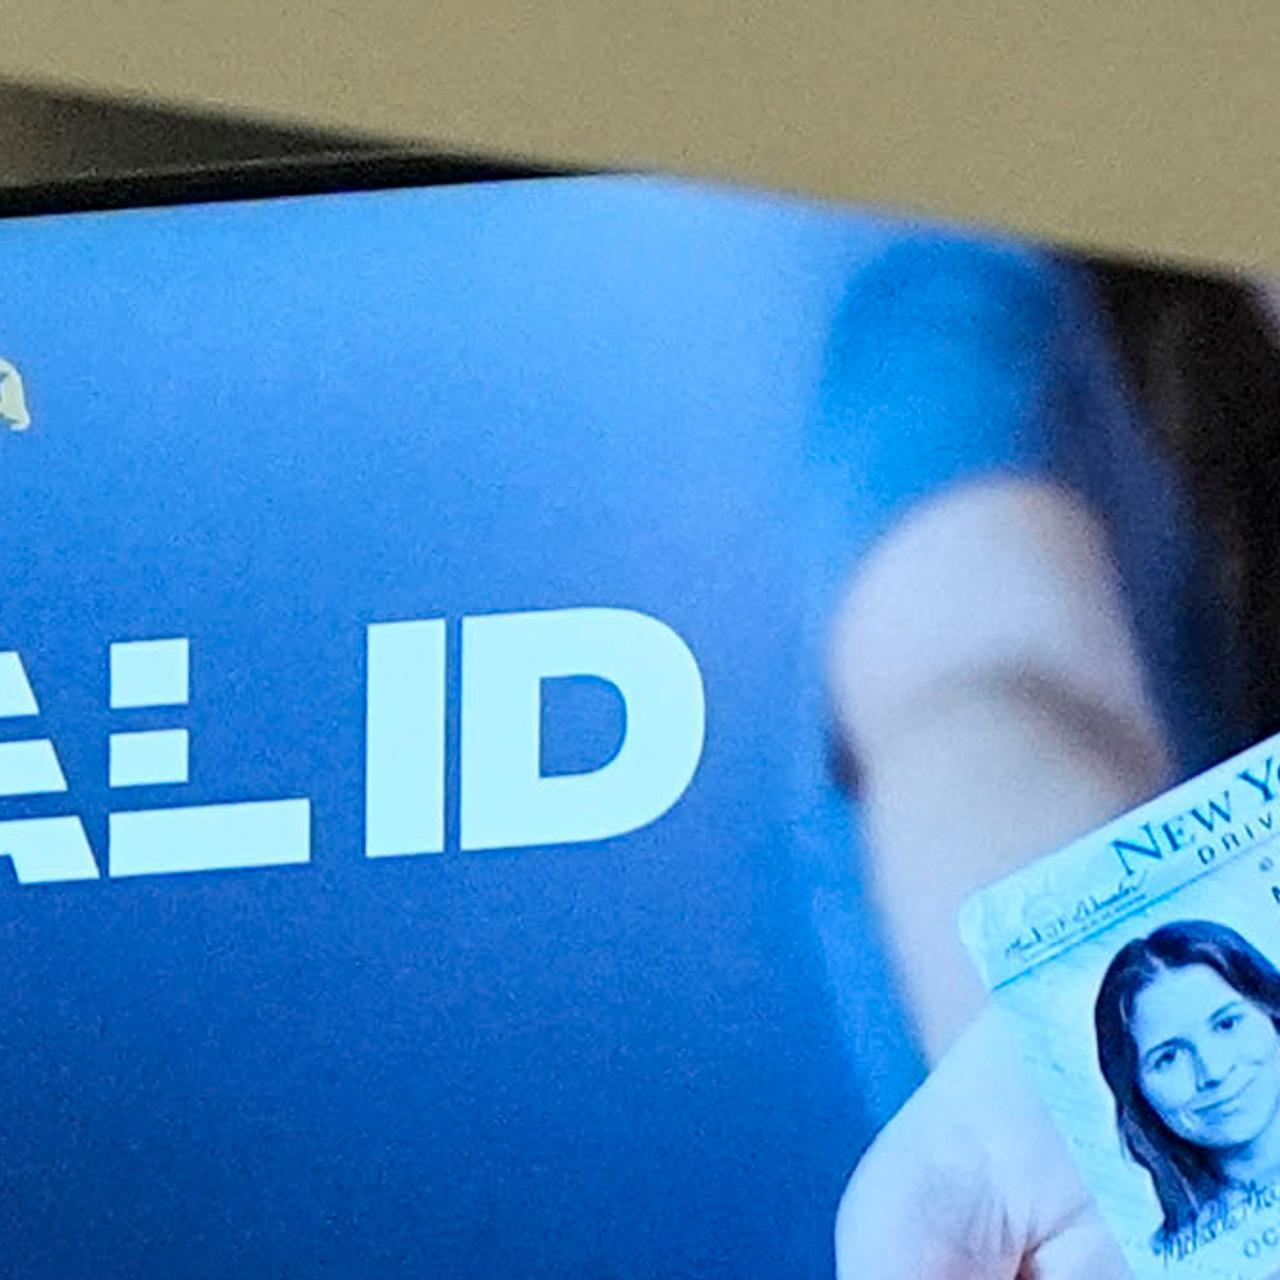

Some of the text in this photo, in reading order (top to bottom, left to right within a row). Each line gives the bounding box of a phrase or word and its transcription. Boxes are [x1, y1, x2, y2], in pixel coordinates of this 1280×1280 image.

[365, 606, 707, 858] ID
[1110, 756, 1280, 877] NEW Y
